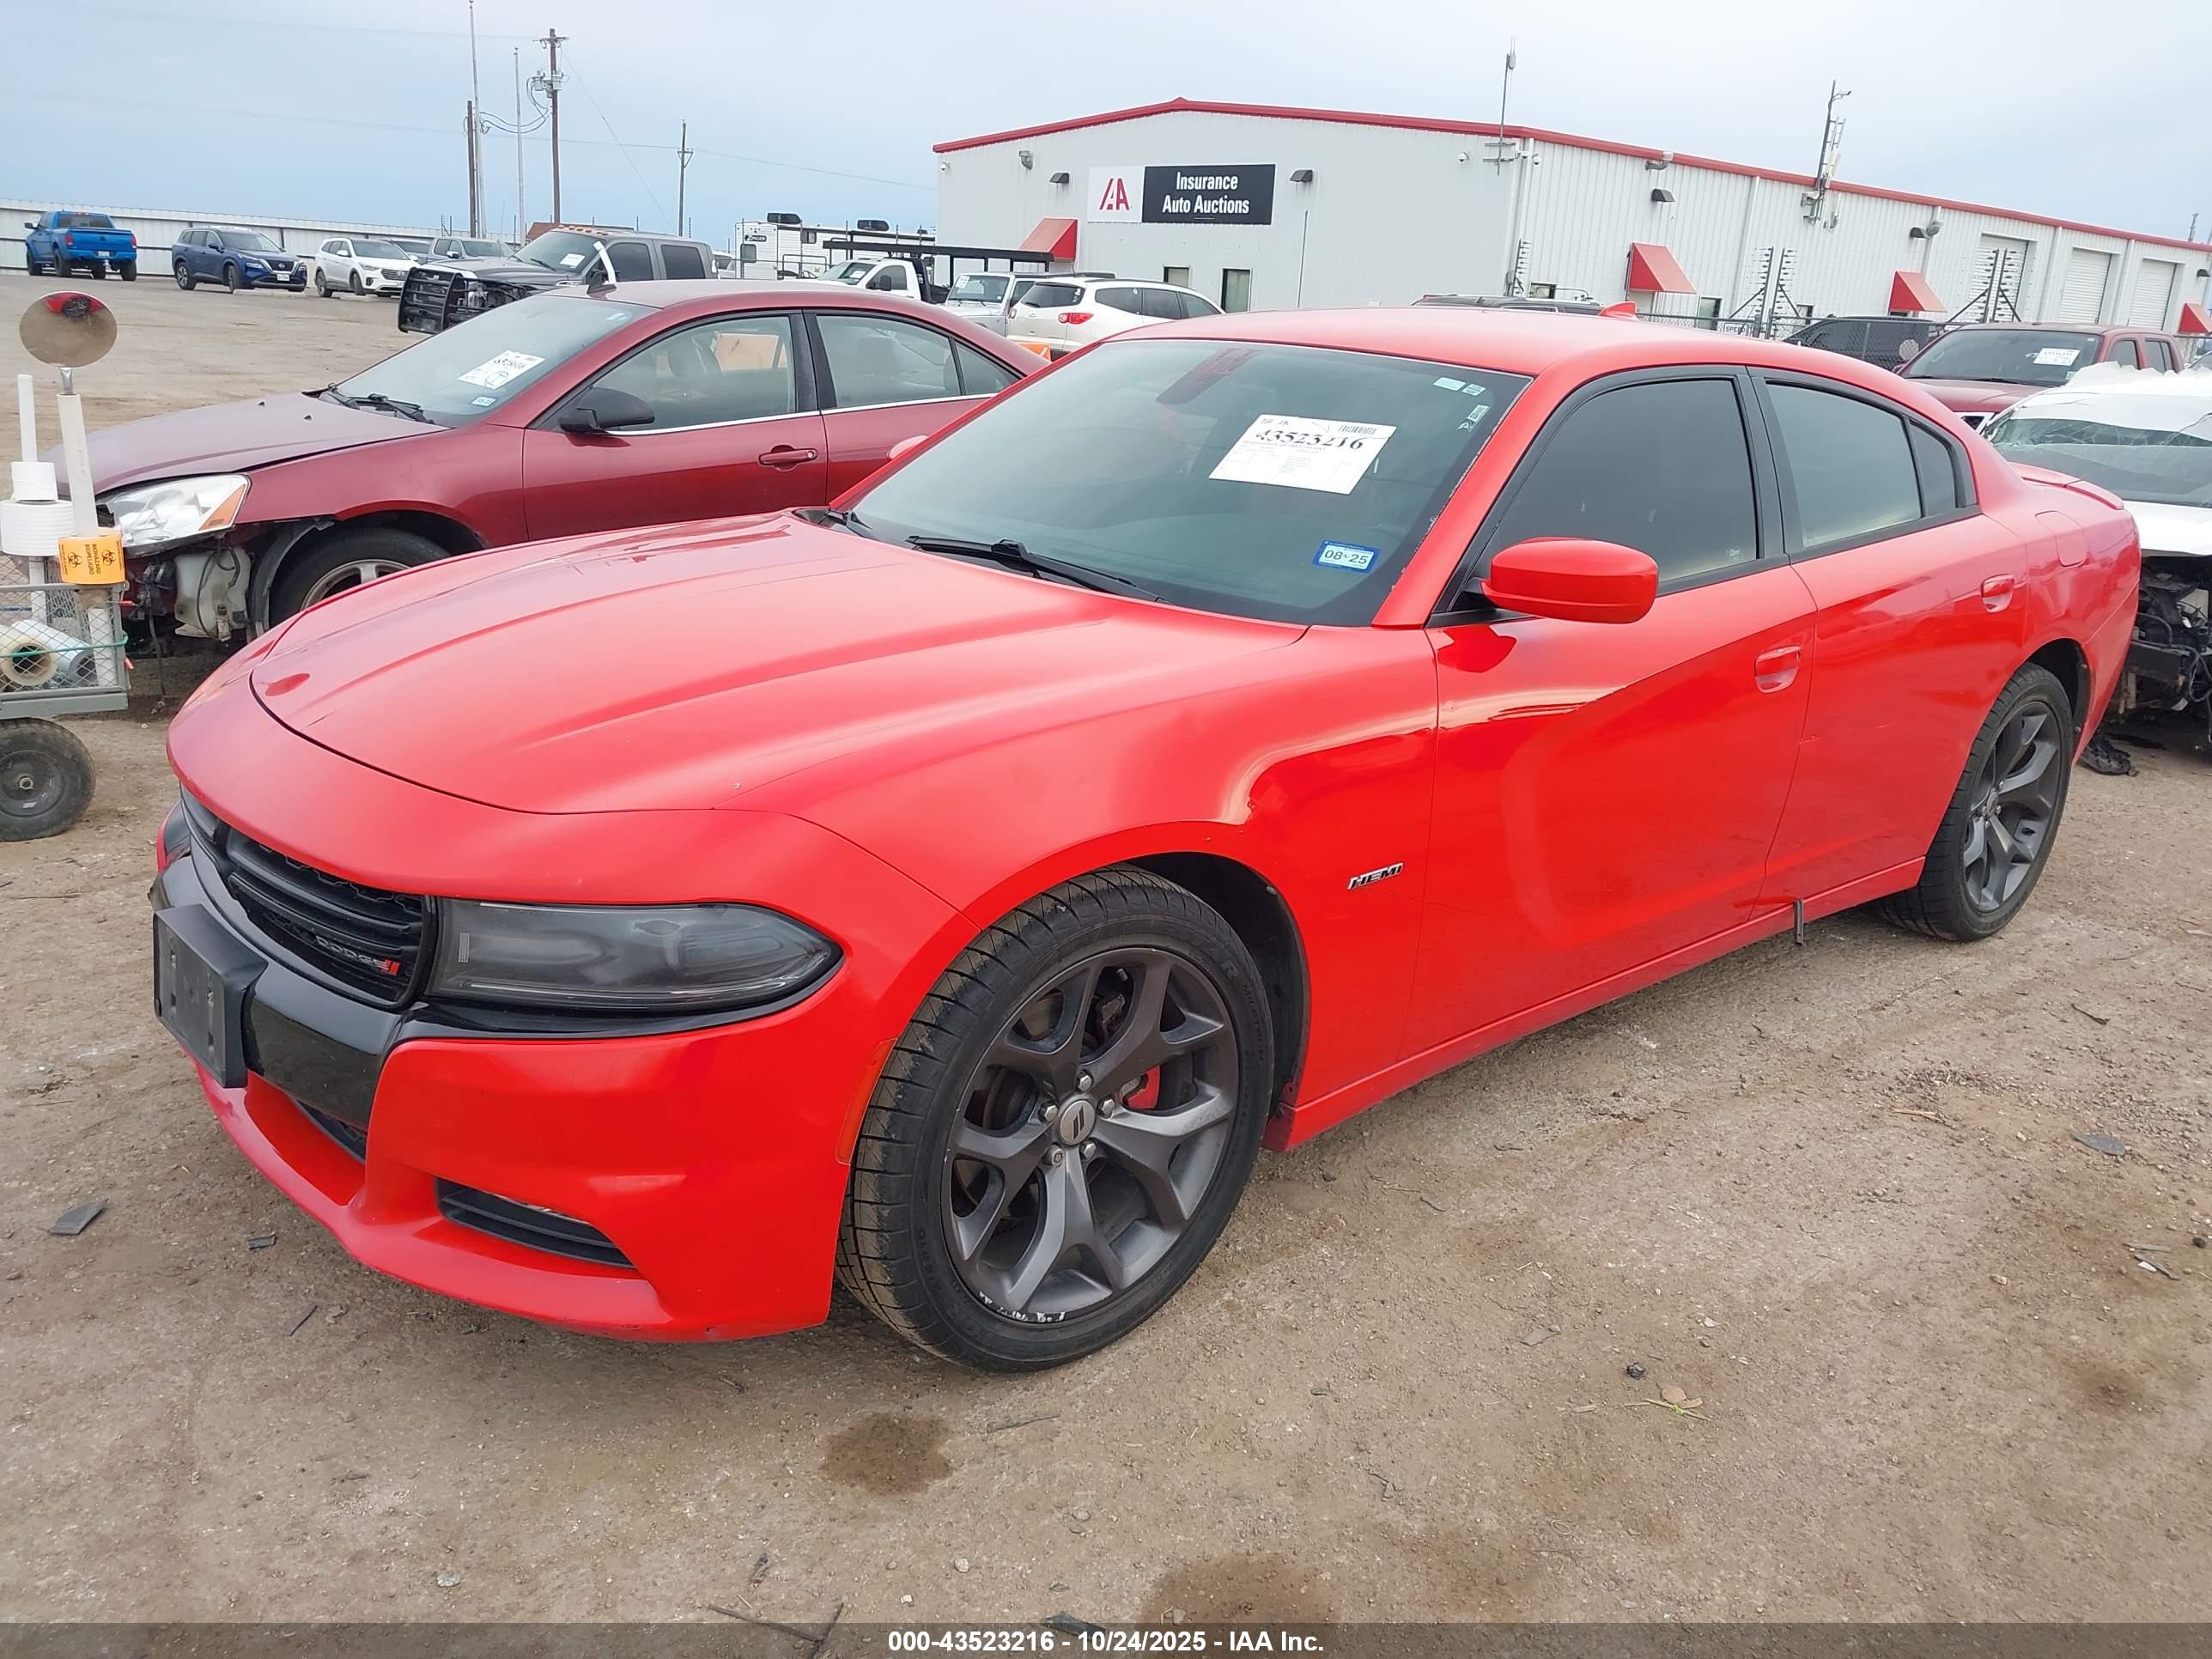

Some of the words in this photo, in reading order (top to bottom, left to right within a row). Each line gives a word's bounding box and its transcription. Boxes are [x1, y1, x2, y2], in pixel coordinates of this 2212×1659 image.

[1176, 171, 1238, 191] Insurance
[1162, 195, 1191, 214] Auto
[1194, 194, 1250, 214] Auctions
[1347, 862, 1404, 890] HEMI
[315, 935, 389, 970] DODGE
